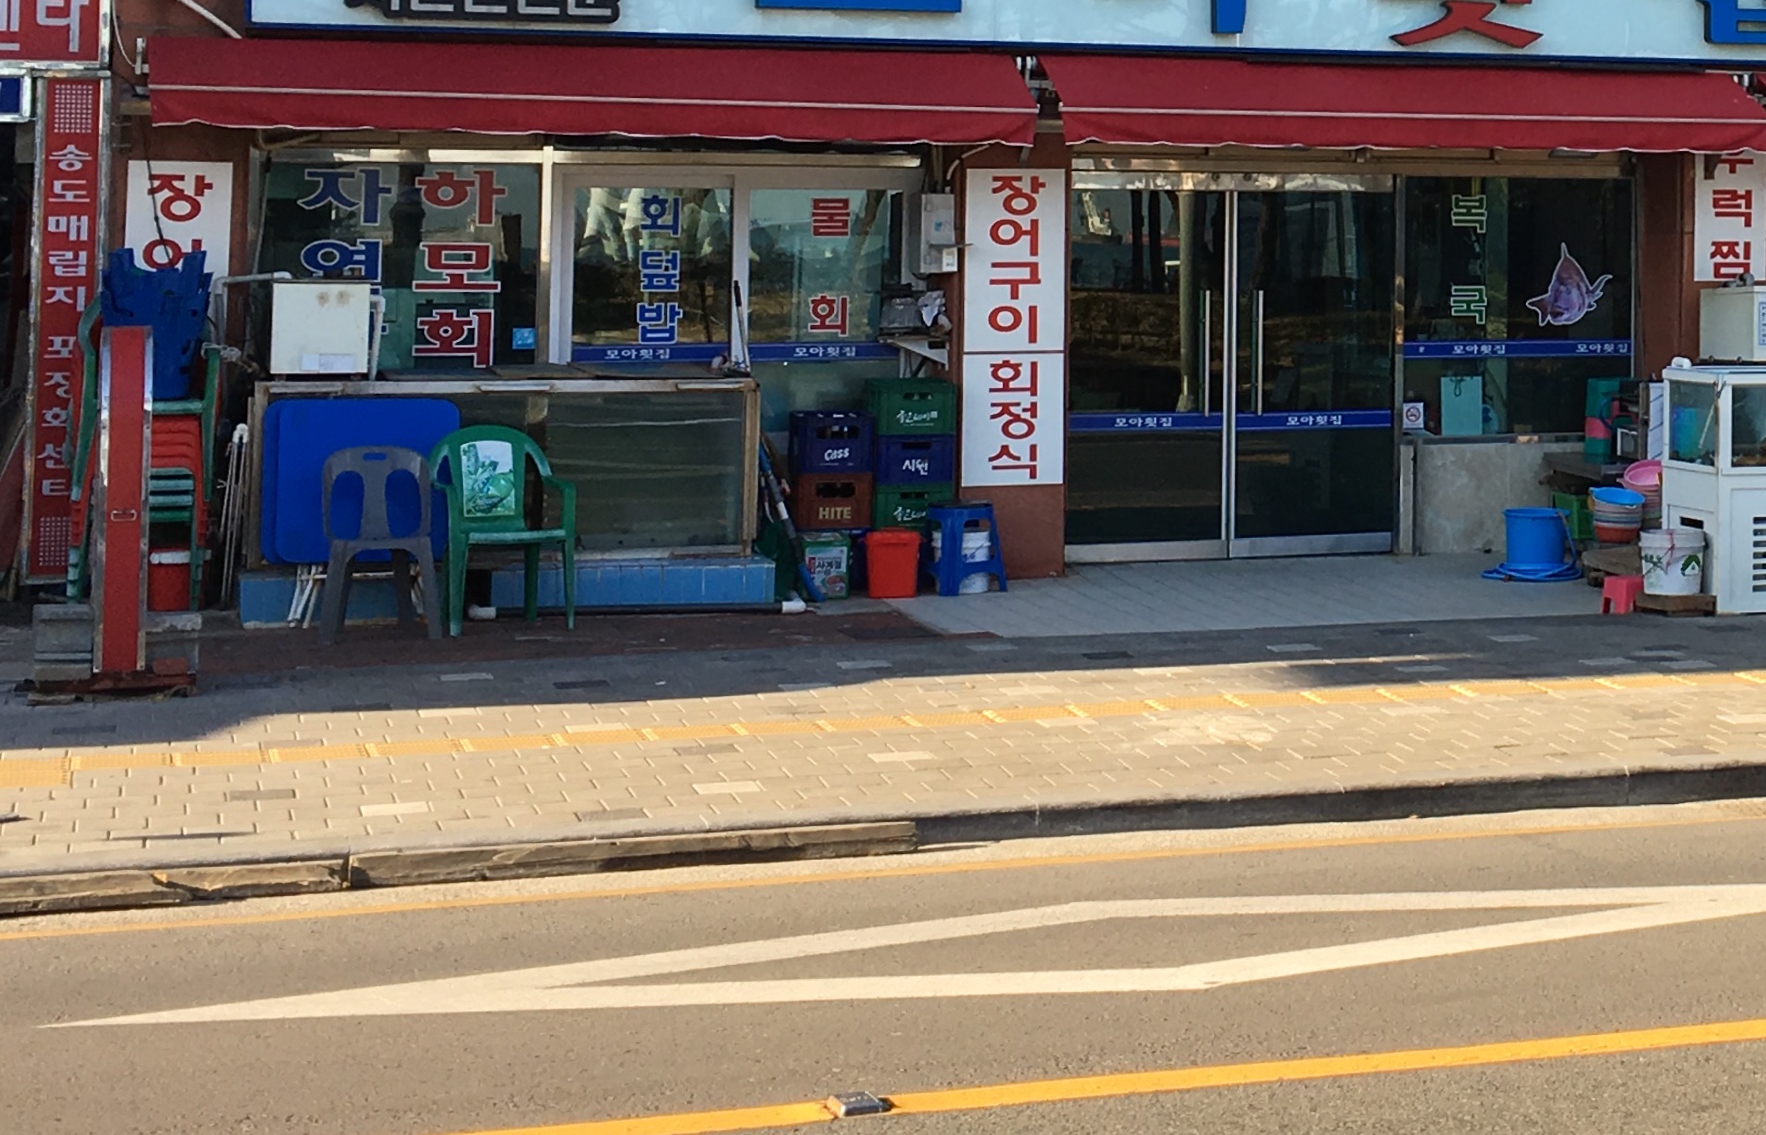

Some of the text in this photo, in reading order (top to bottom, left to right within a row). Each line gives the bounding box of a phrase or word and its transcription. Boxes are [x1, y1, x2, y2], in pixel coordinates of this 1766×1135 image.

[44, 144, 93, 312] 송도매립지
[807, 196, 852, 337] 물회
[987, 175, 1046, 344] 장어구이
[1450, 194, 1488, 325] 복국
[412, 169, 508, 368] 하모회
[636, 194, 682, 344] 회덮밥
[605, 347, 671, 360] 모아횟집
[793, 345, 857, 358] 모아횟집
[1452, 343, 1506, 355] 모아횟집
[1575, 342, 1628, 354] 모아횟집
[987, 359, 1039, 479] 회정식
[1114, 415, 1173, 428] 모아횟집
[1286, 414, 1342, 426] 모아횟집
[824, 447, 850, 461] Cass
[818, 507, 852, 520] HITE
